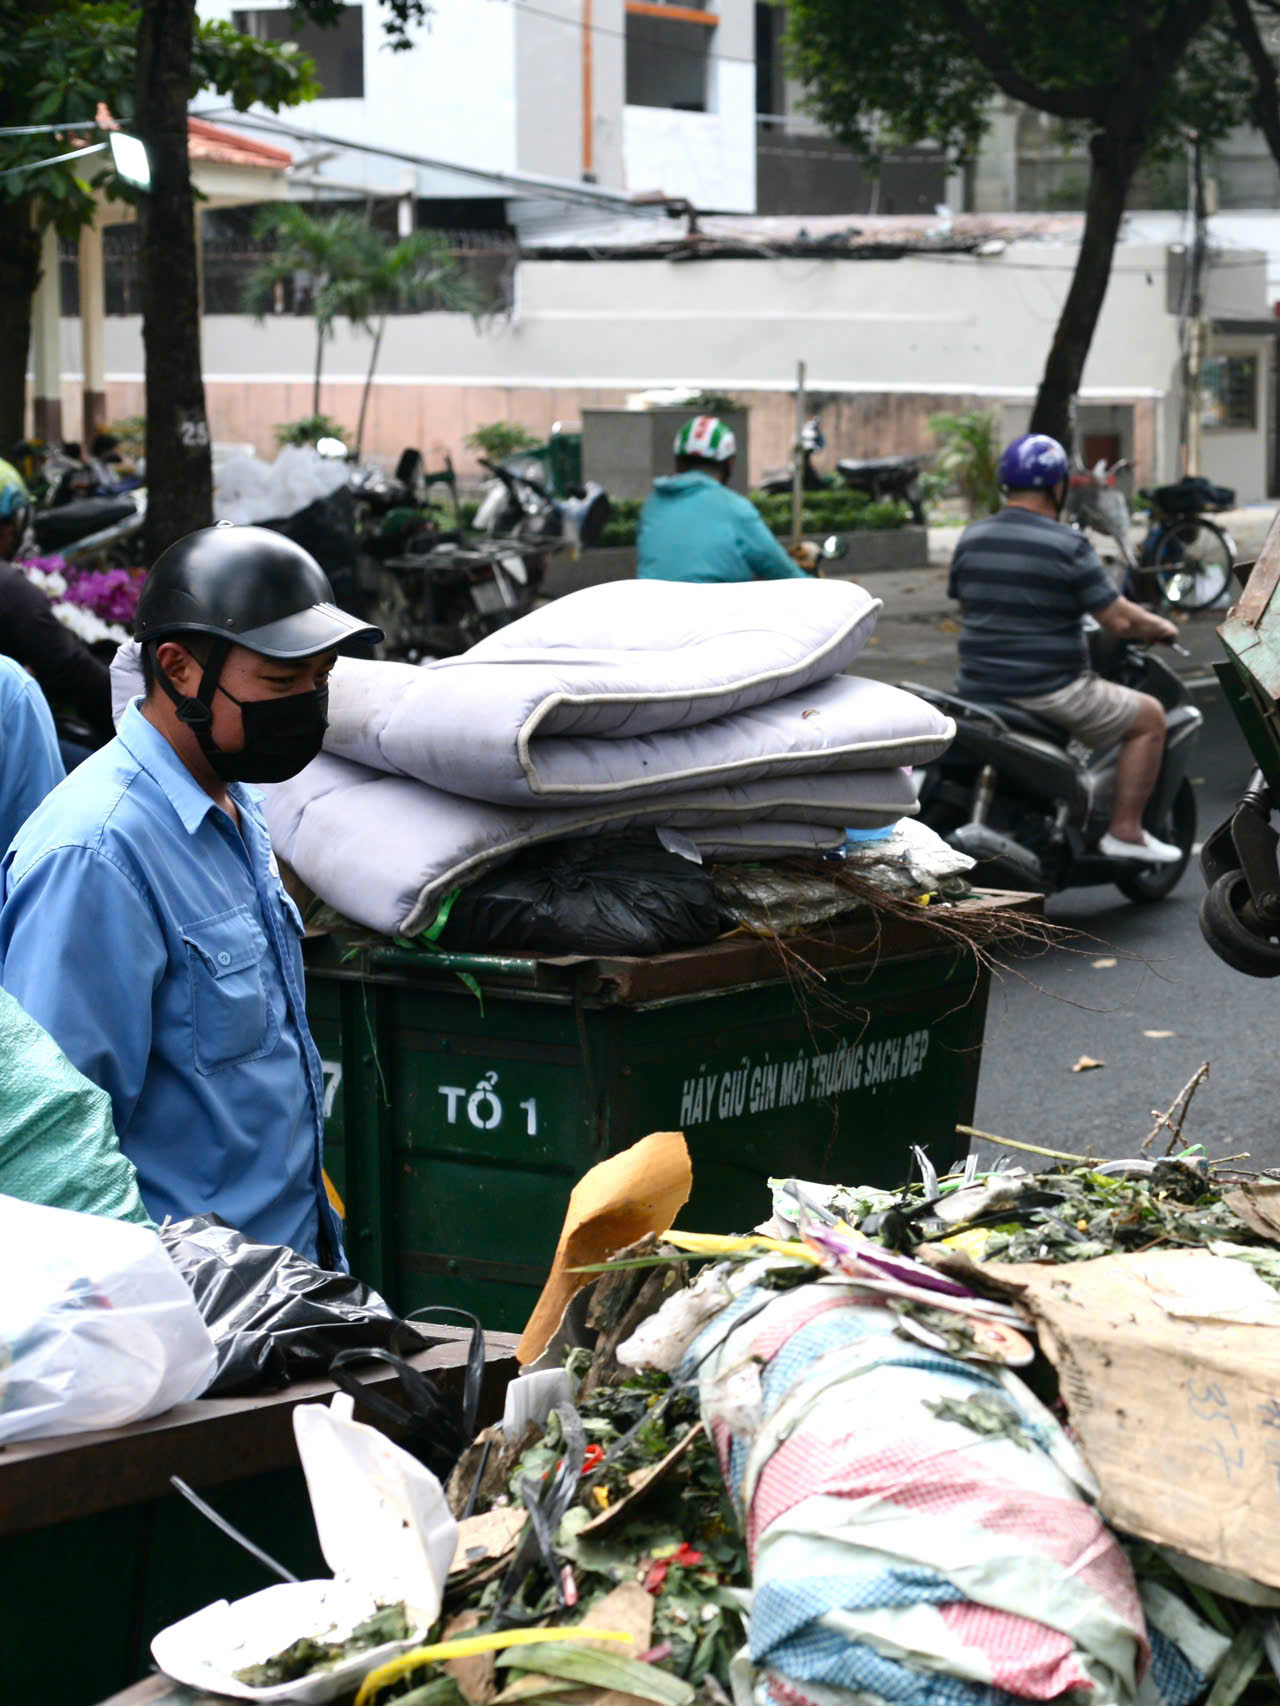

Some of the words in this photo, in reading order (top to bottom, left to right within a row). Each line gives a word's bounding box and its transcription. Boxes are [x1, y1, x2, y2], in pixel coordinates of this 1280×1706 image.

[438, 1070, 503, 1130] TỔ
[520, 1097, 537, 1136] 1
[779, 1048, 809, 1107] MÔI
